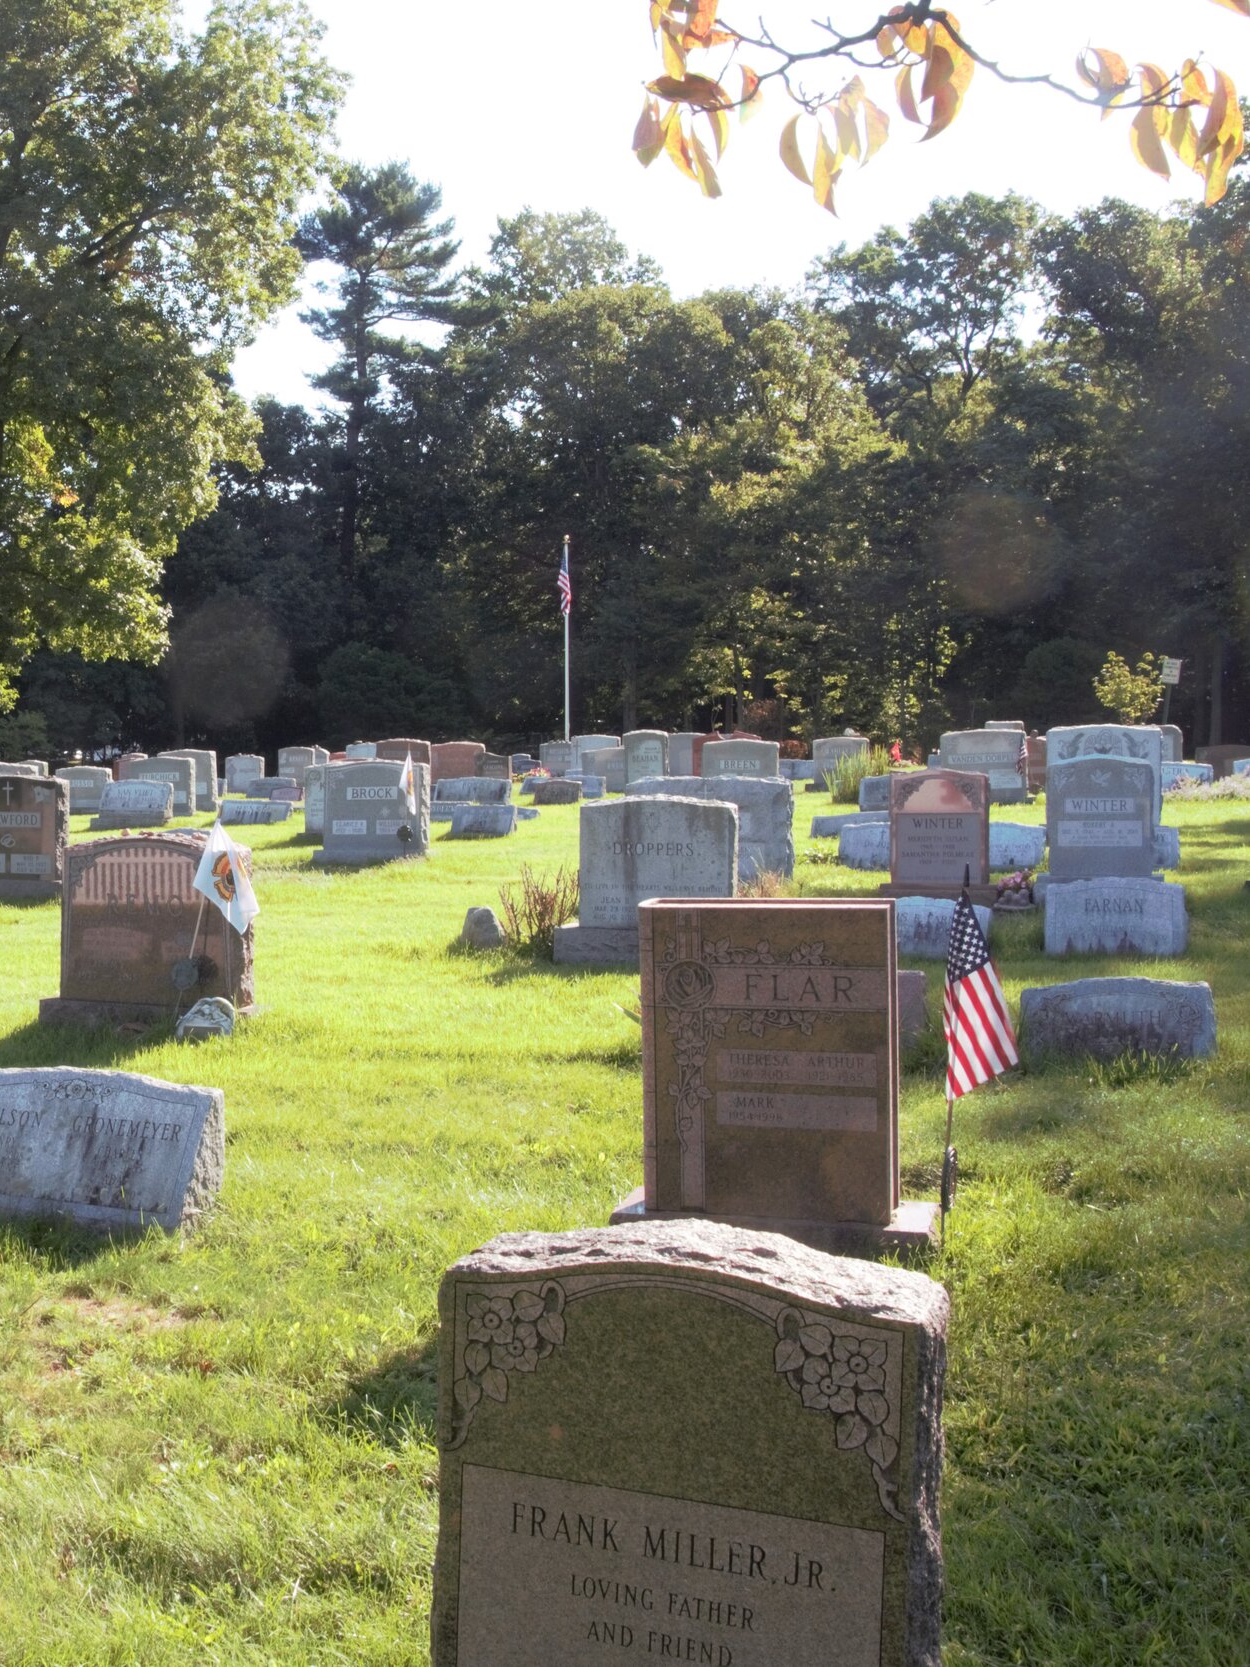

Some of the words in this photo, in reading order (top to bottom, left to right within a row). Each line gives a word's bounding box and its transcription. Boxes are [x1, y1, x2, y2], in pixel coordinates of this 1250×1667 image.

[723, 760, 756, 769] BREEN
[351, 787, 393, 799] BROCK
[1071, 799, 1127, 812] WINTER
[912, 818, 964, 829] WINTER
[613, 842, 695, 857] DROPPERS
[1083, 898, 1144, 914] FARNAN
[745, 974, 855, 1003] FLAR
[1063, 1010, 1161, 1025] WARMUTH
[729, 1053, 790, 1067] THERESA
[808, 1055, 865, 1069] ARTHUR
[734, 1096, 774, 1109] MARK
[72, 1115, 182, 1142] GRONEMEYER
[511, 1501, 620, 1553] FRANK
[784, 1552, 837, 1592] JR.
[571, 1574, 654, 1612] LOVING
[667, 1591, 756, 1633] FATHER
[587, 1621, 634, 1648] AND
[648, 1630, 733, 1667] FRIEND
